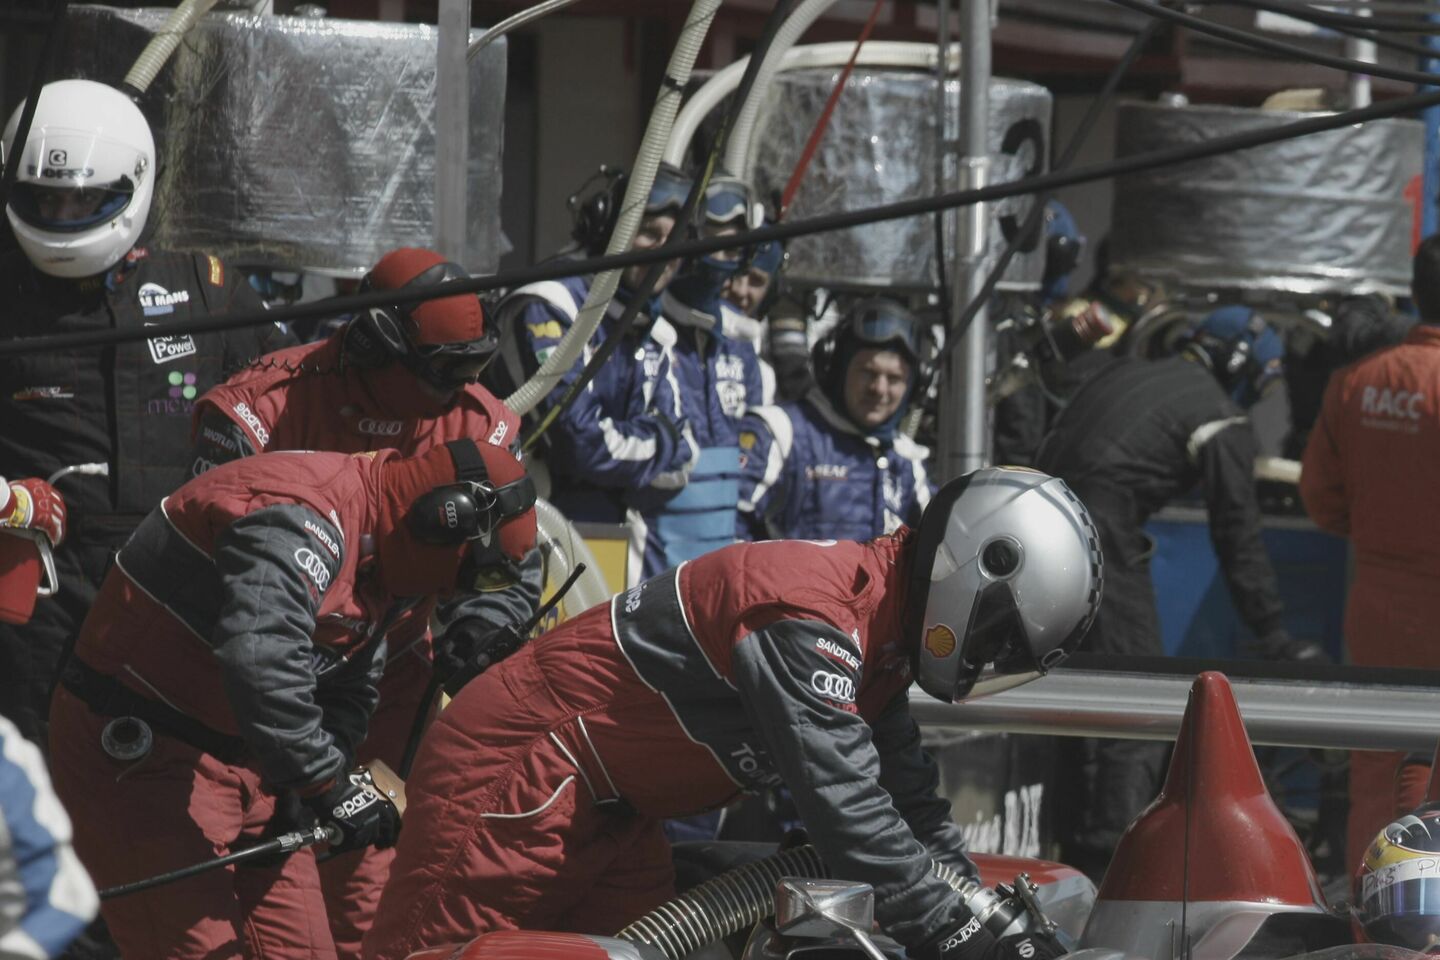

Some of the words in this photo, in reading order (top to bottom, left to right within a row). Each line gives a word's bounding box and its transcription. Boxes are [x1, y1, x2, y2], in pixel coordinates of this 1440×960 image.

[155, 290, 189, 306] MANS
[155, 341, 193, 358] Power
[1362, 386, 1425, 420] RACC
[234, 402, 270, 448] sparco
[939, 917, 982, 952] sparco
